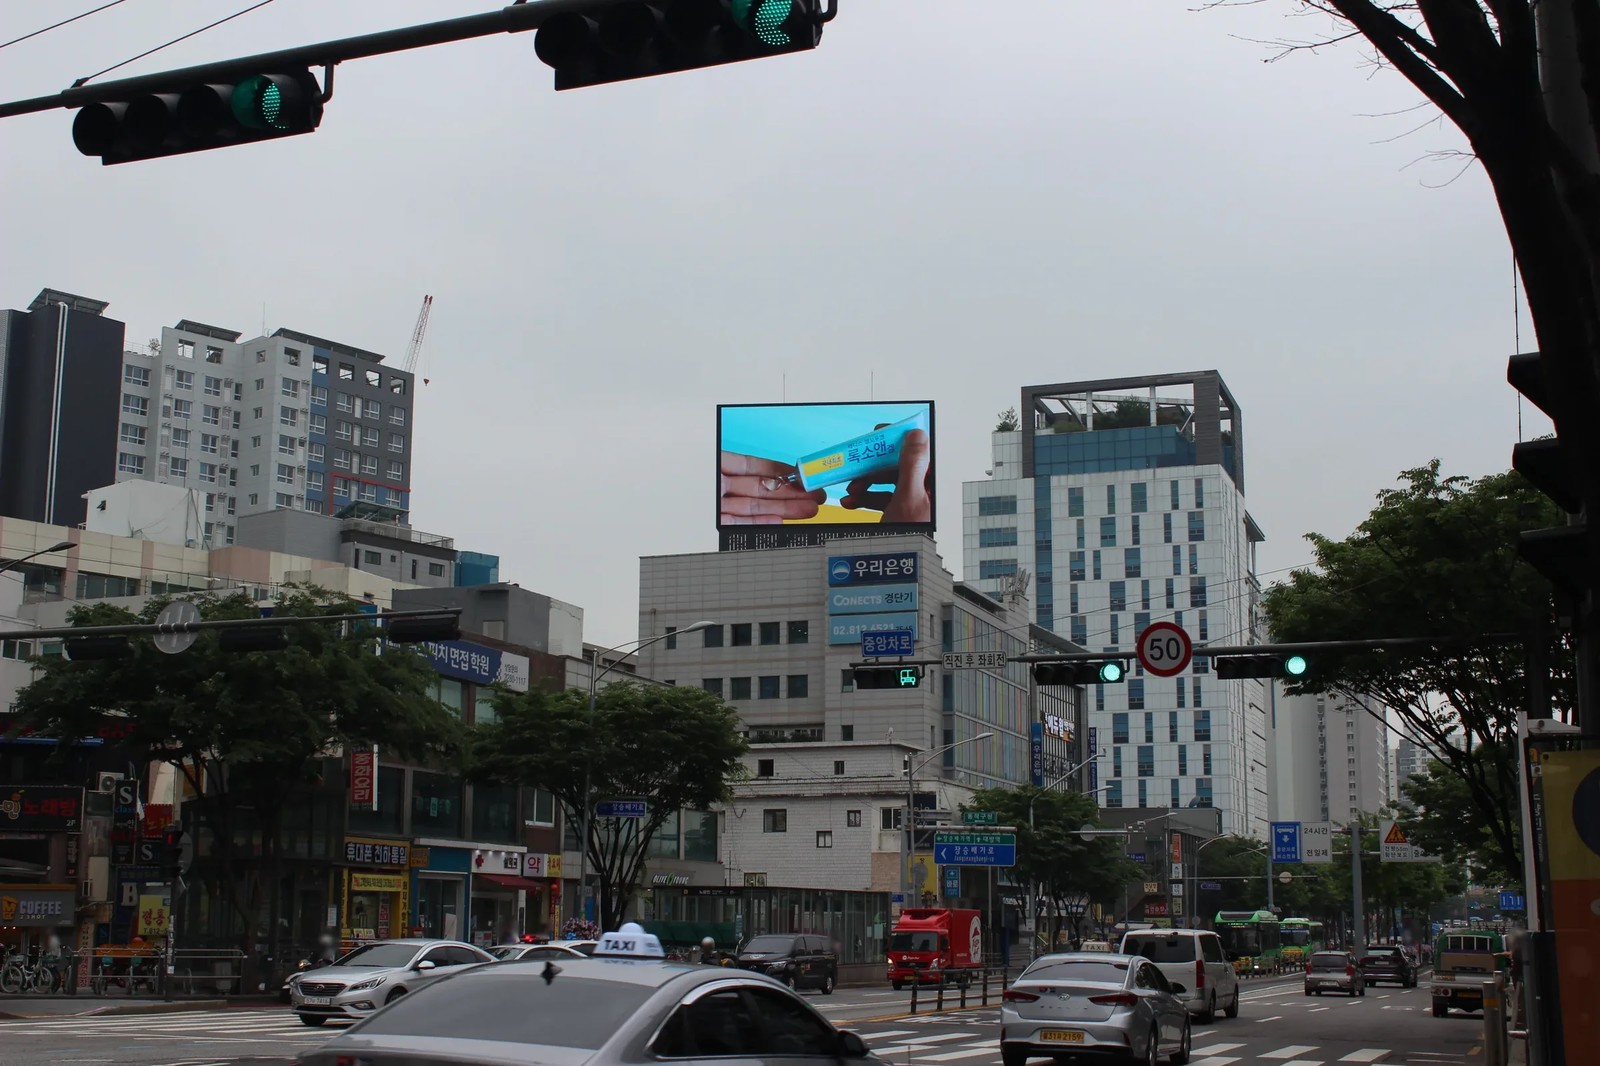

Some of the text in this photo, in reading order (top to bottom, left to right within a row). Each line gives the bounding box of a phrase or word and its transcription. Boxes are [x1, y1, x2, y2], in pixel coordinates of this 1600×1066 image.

[854, 558, 914, 577] 우리은행
[884, 592, 913, 604] 경단기
[863, 636, 912, 651] 중앙차로
[1150, 637, 1180, 661] 50
[945, 653, 1006, 667] 직진 후 좌회전
[1304, 827, 1328, 835] 24시간
[346, 843, 372, 863] 휴대폰
[954, 846, 994, 855] 장승배기로
[1306, 849, 1328, 857] 전일제
[528, 857, 541, 874] 약
[20, 900, 62, 915] COFFEE
[604, 939, 636, 951] TAXI
